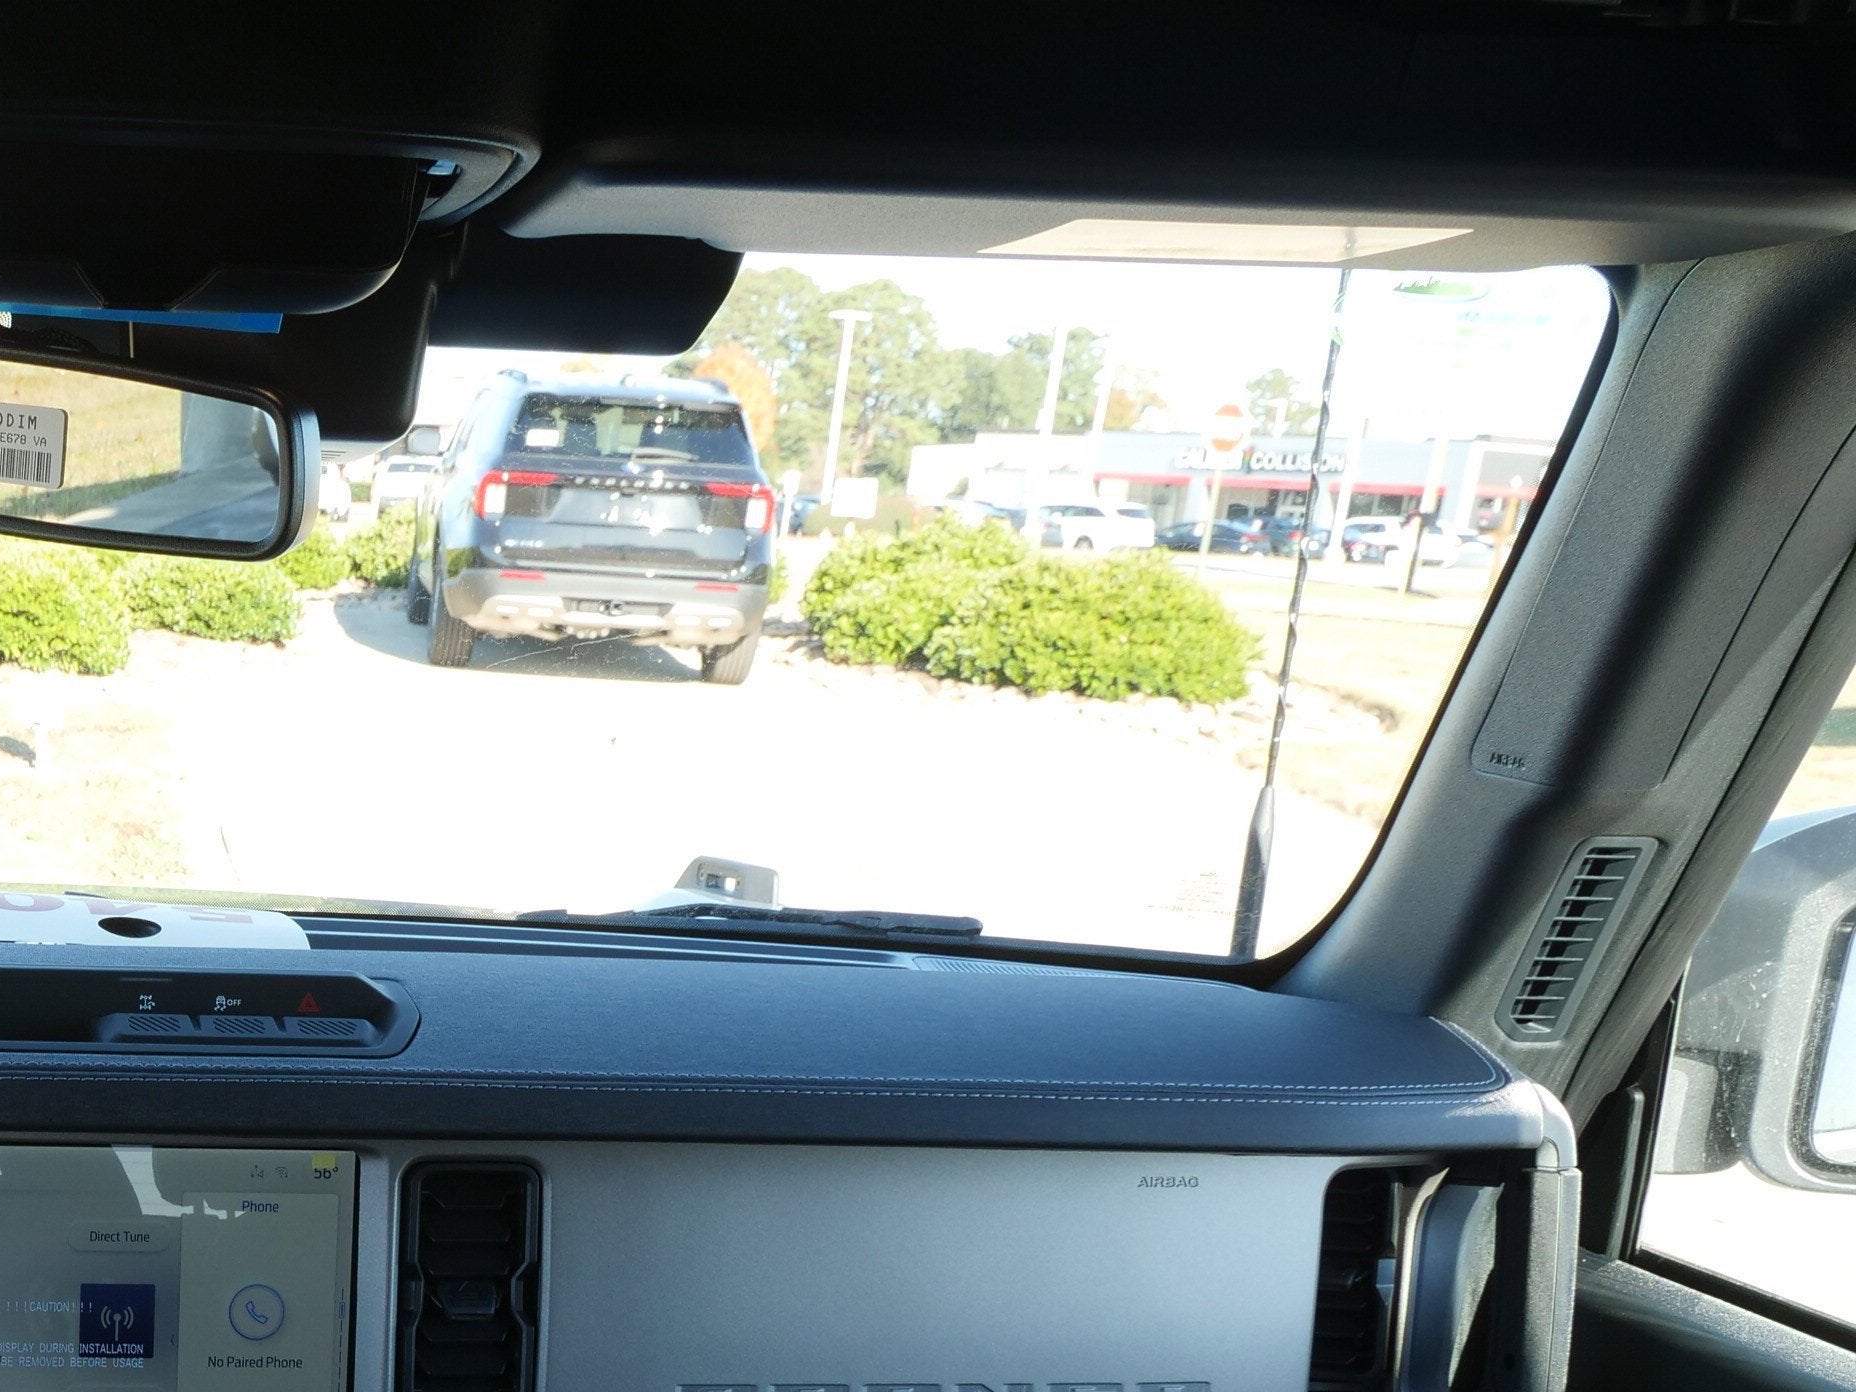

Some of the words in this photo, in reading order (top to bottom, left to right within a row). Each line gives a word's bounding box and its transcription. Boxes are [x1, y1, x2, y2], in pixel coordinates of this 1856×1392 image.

[33, 435, 47, 447] VA
[227, 998, 242, 1007] OFF
[1137, 1176, 1199, 1188] AIRBAG
[242, 1201, 279, 1213] Phone
[90, 1231, 120, 1242] Direct
[123, 1232, 150, 1242] Tune
[39, 1343, 75, 1353] DURING
[79, 1343, 144, 1354] INSTALLATION
[1, 1357, 13, 1367] BE
[19, 1357, 65, 1367] REMOVED
[70, 1358, 107, 1368] BEFORE
[113, 1358, 144, 1368] USAGE
[207, 1356, 224, 1368] No
[226, 1356, 264, 1369] Paired
[266, 1357, 303, 1369] Phone
